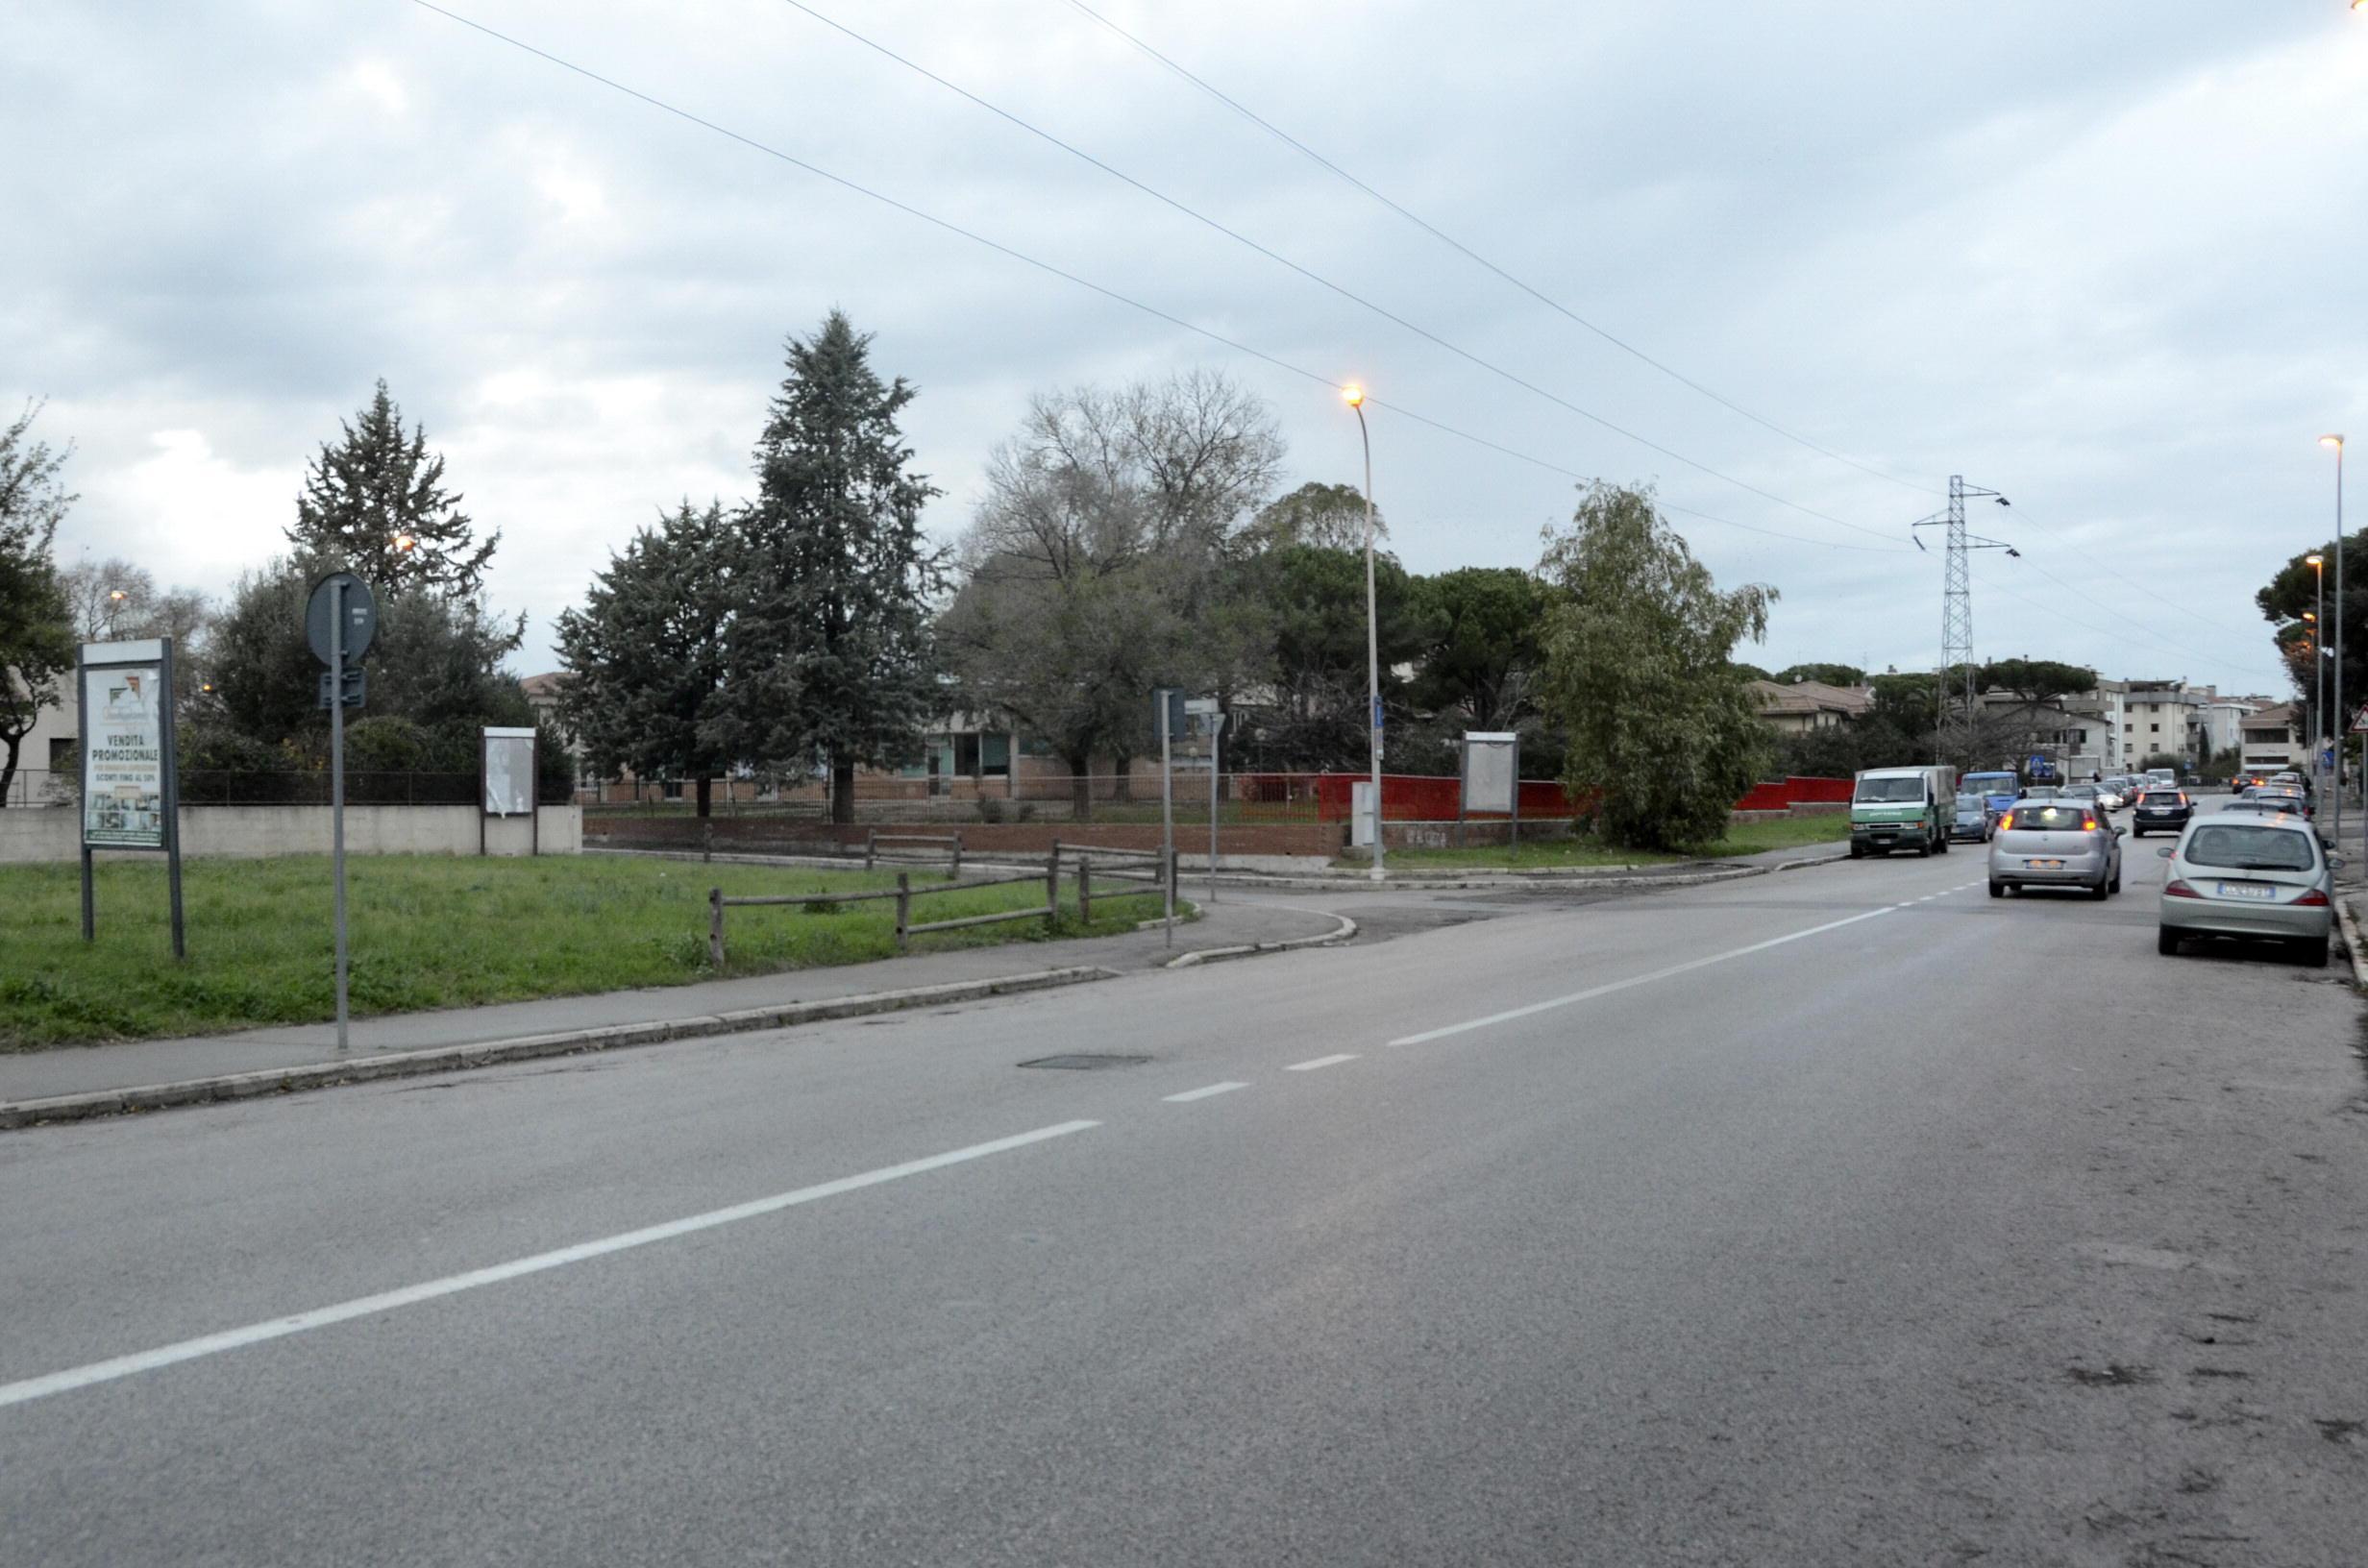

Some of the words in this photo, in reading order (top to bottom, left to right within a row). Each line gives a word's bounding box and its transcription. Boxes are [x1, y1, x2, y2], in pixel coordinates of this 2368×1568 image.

[107, 734, 144, 747] VENDITA
[91, 748, 159, 761] PROMOZIONALE
[96, 773, 117, 782] SCONTI
[119, 773, 133, 782] FINO
